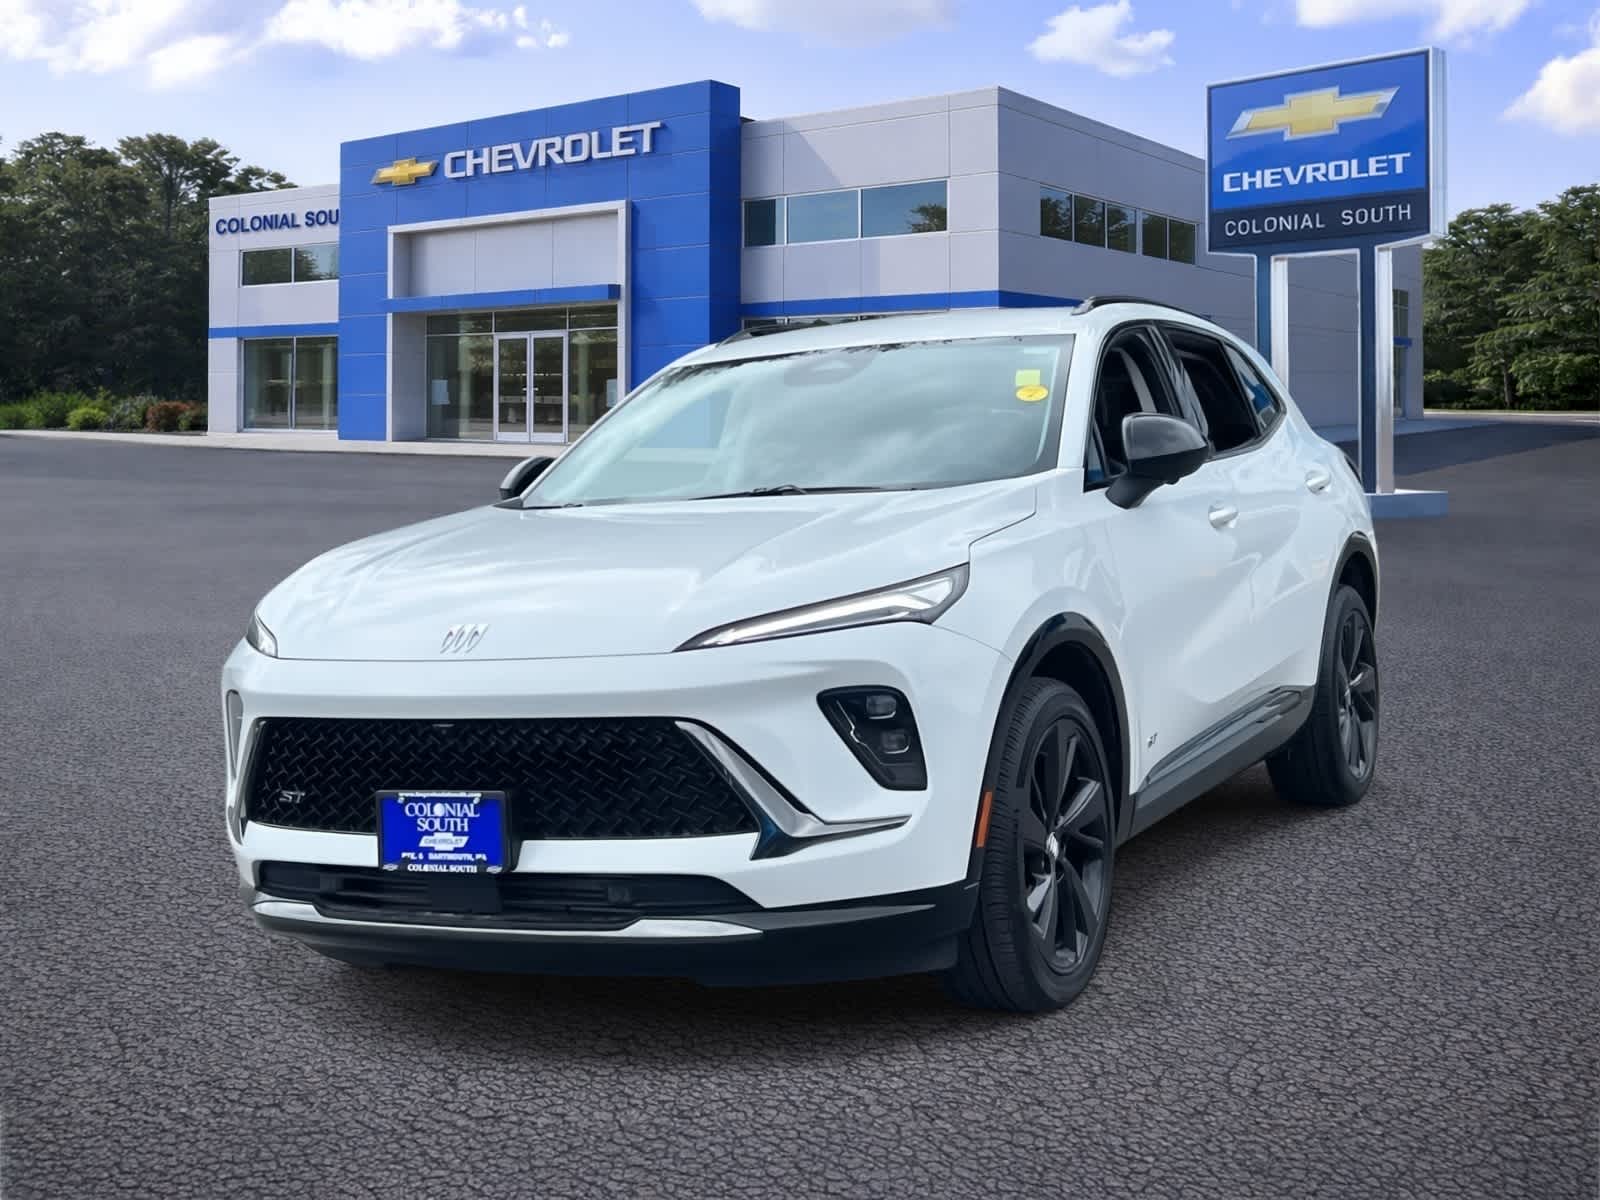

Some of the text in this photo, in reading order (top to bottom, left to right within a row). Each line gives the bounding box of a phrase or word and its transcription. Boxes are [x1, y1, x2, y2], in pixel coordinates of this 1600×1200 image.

[444, 121, 662, 179] CHEVROLET
[1223, 152, 1411, 192] CHEVROLET
[215, 212, 301, 235] COLONIAL
[1225, 203, 1412, 237] COLONIAL SOUTH
[279, 789, 306, 804] ST
[417, 817, 469, 832] SOUTH
[407, 863, 478, 874] COLONIAL SOUTH
